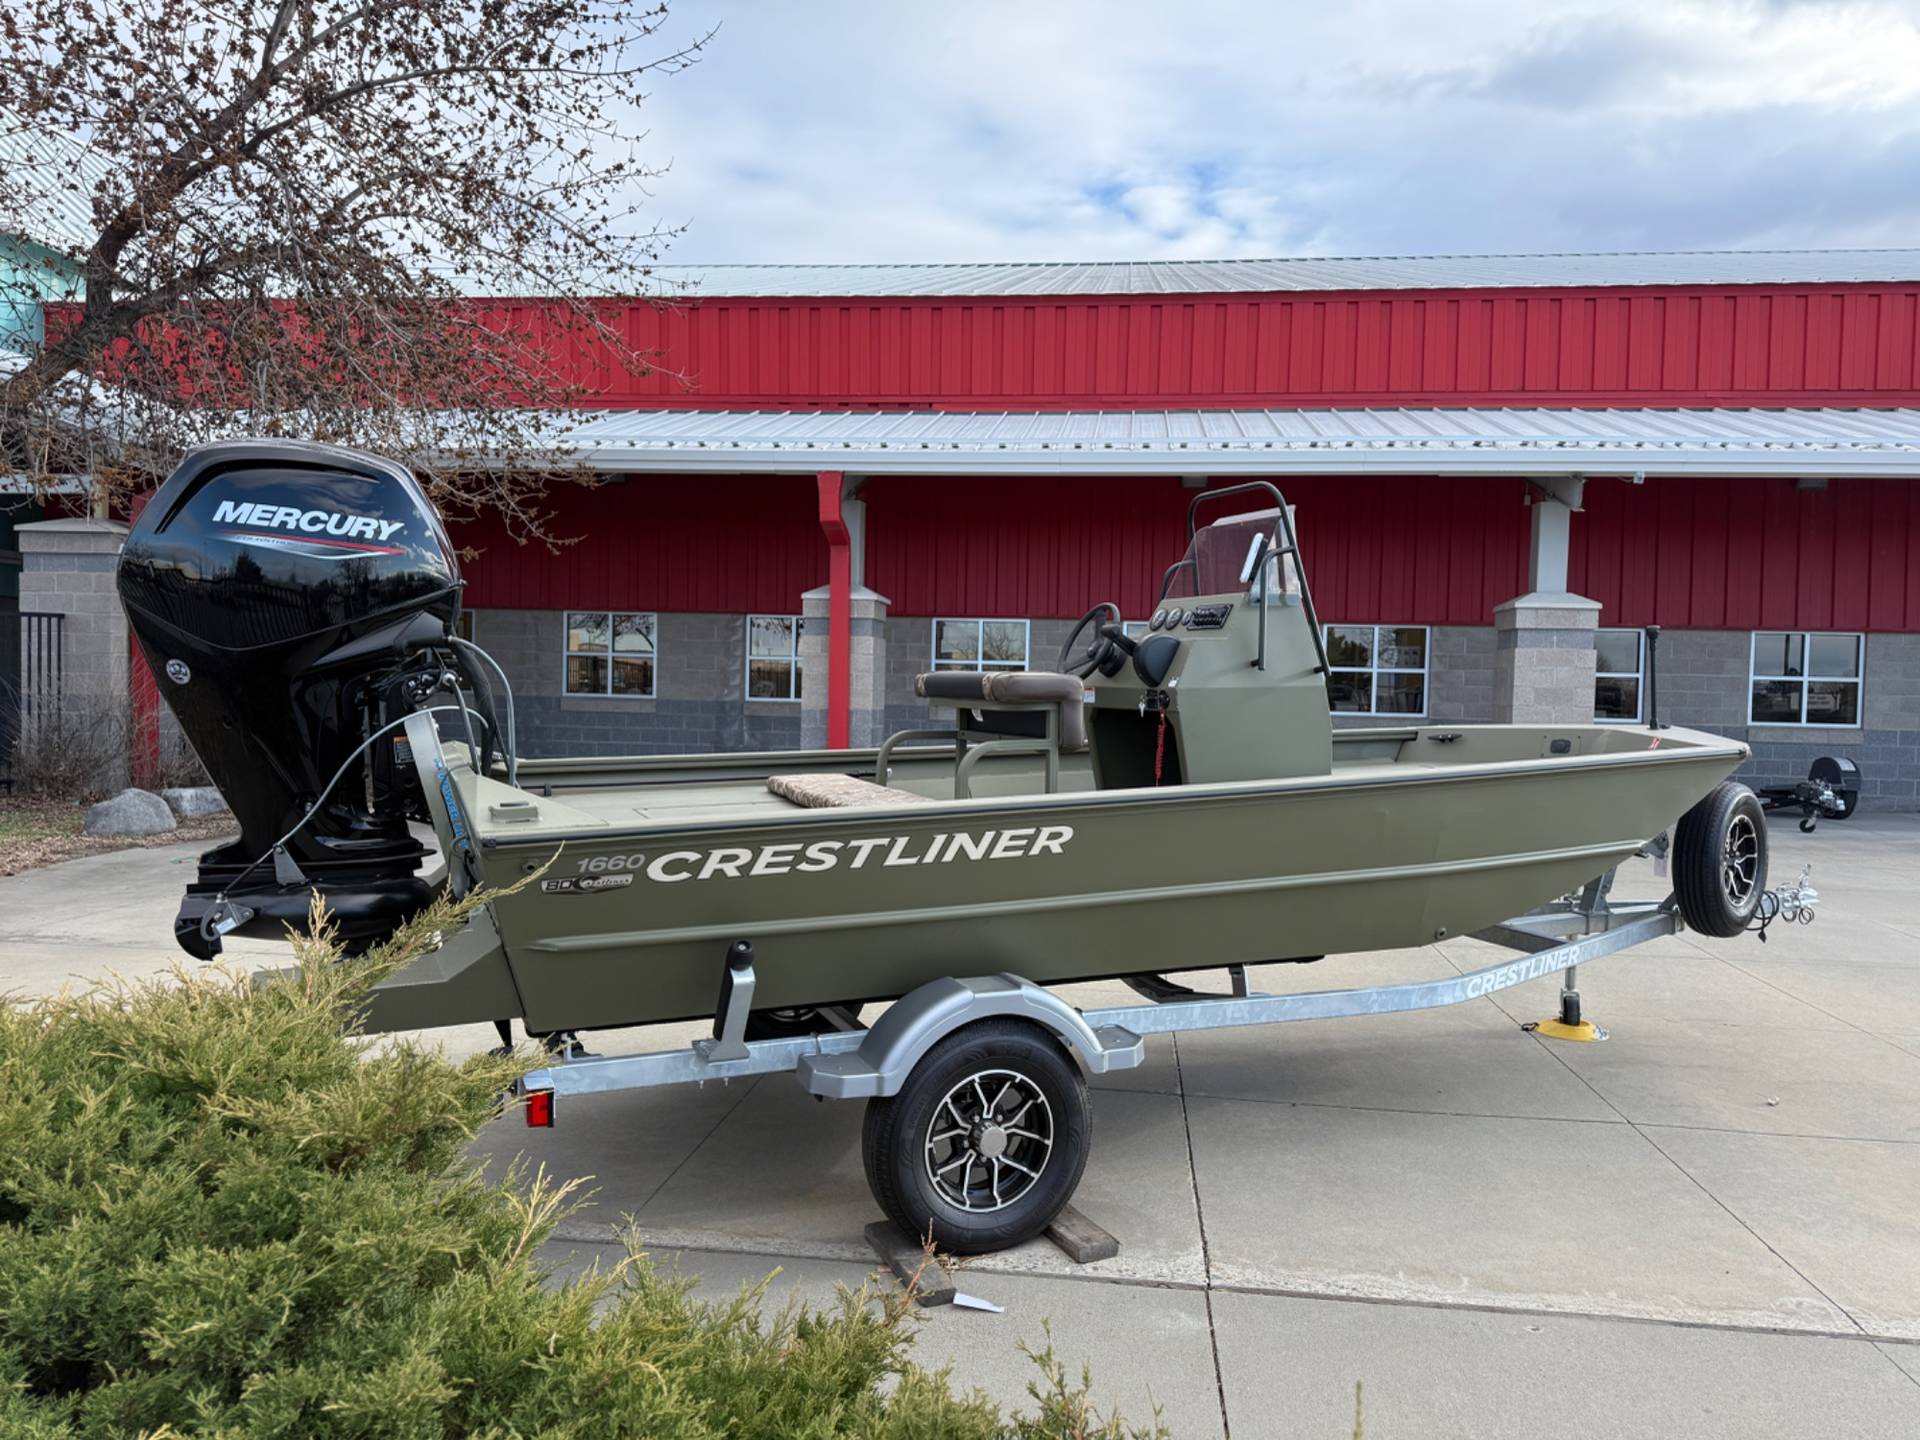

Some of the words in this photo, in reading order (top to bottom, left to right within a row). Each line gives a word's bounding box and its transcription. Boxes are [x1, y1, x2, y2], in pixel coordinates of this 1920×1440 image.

[212, 500, 404, 541] MERCURY
[576, 854, 646, 873] 1660
[646, 825, 1074, 882] CRESTLINER
[1467, 945, 1580, 998] CRESTLINER
